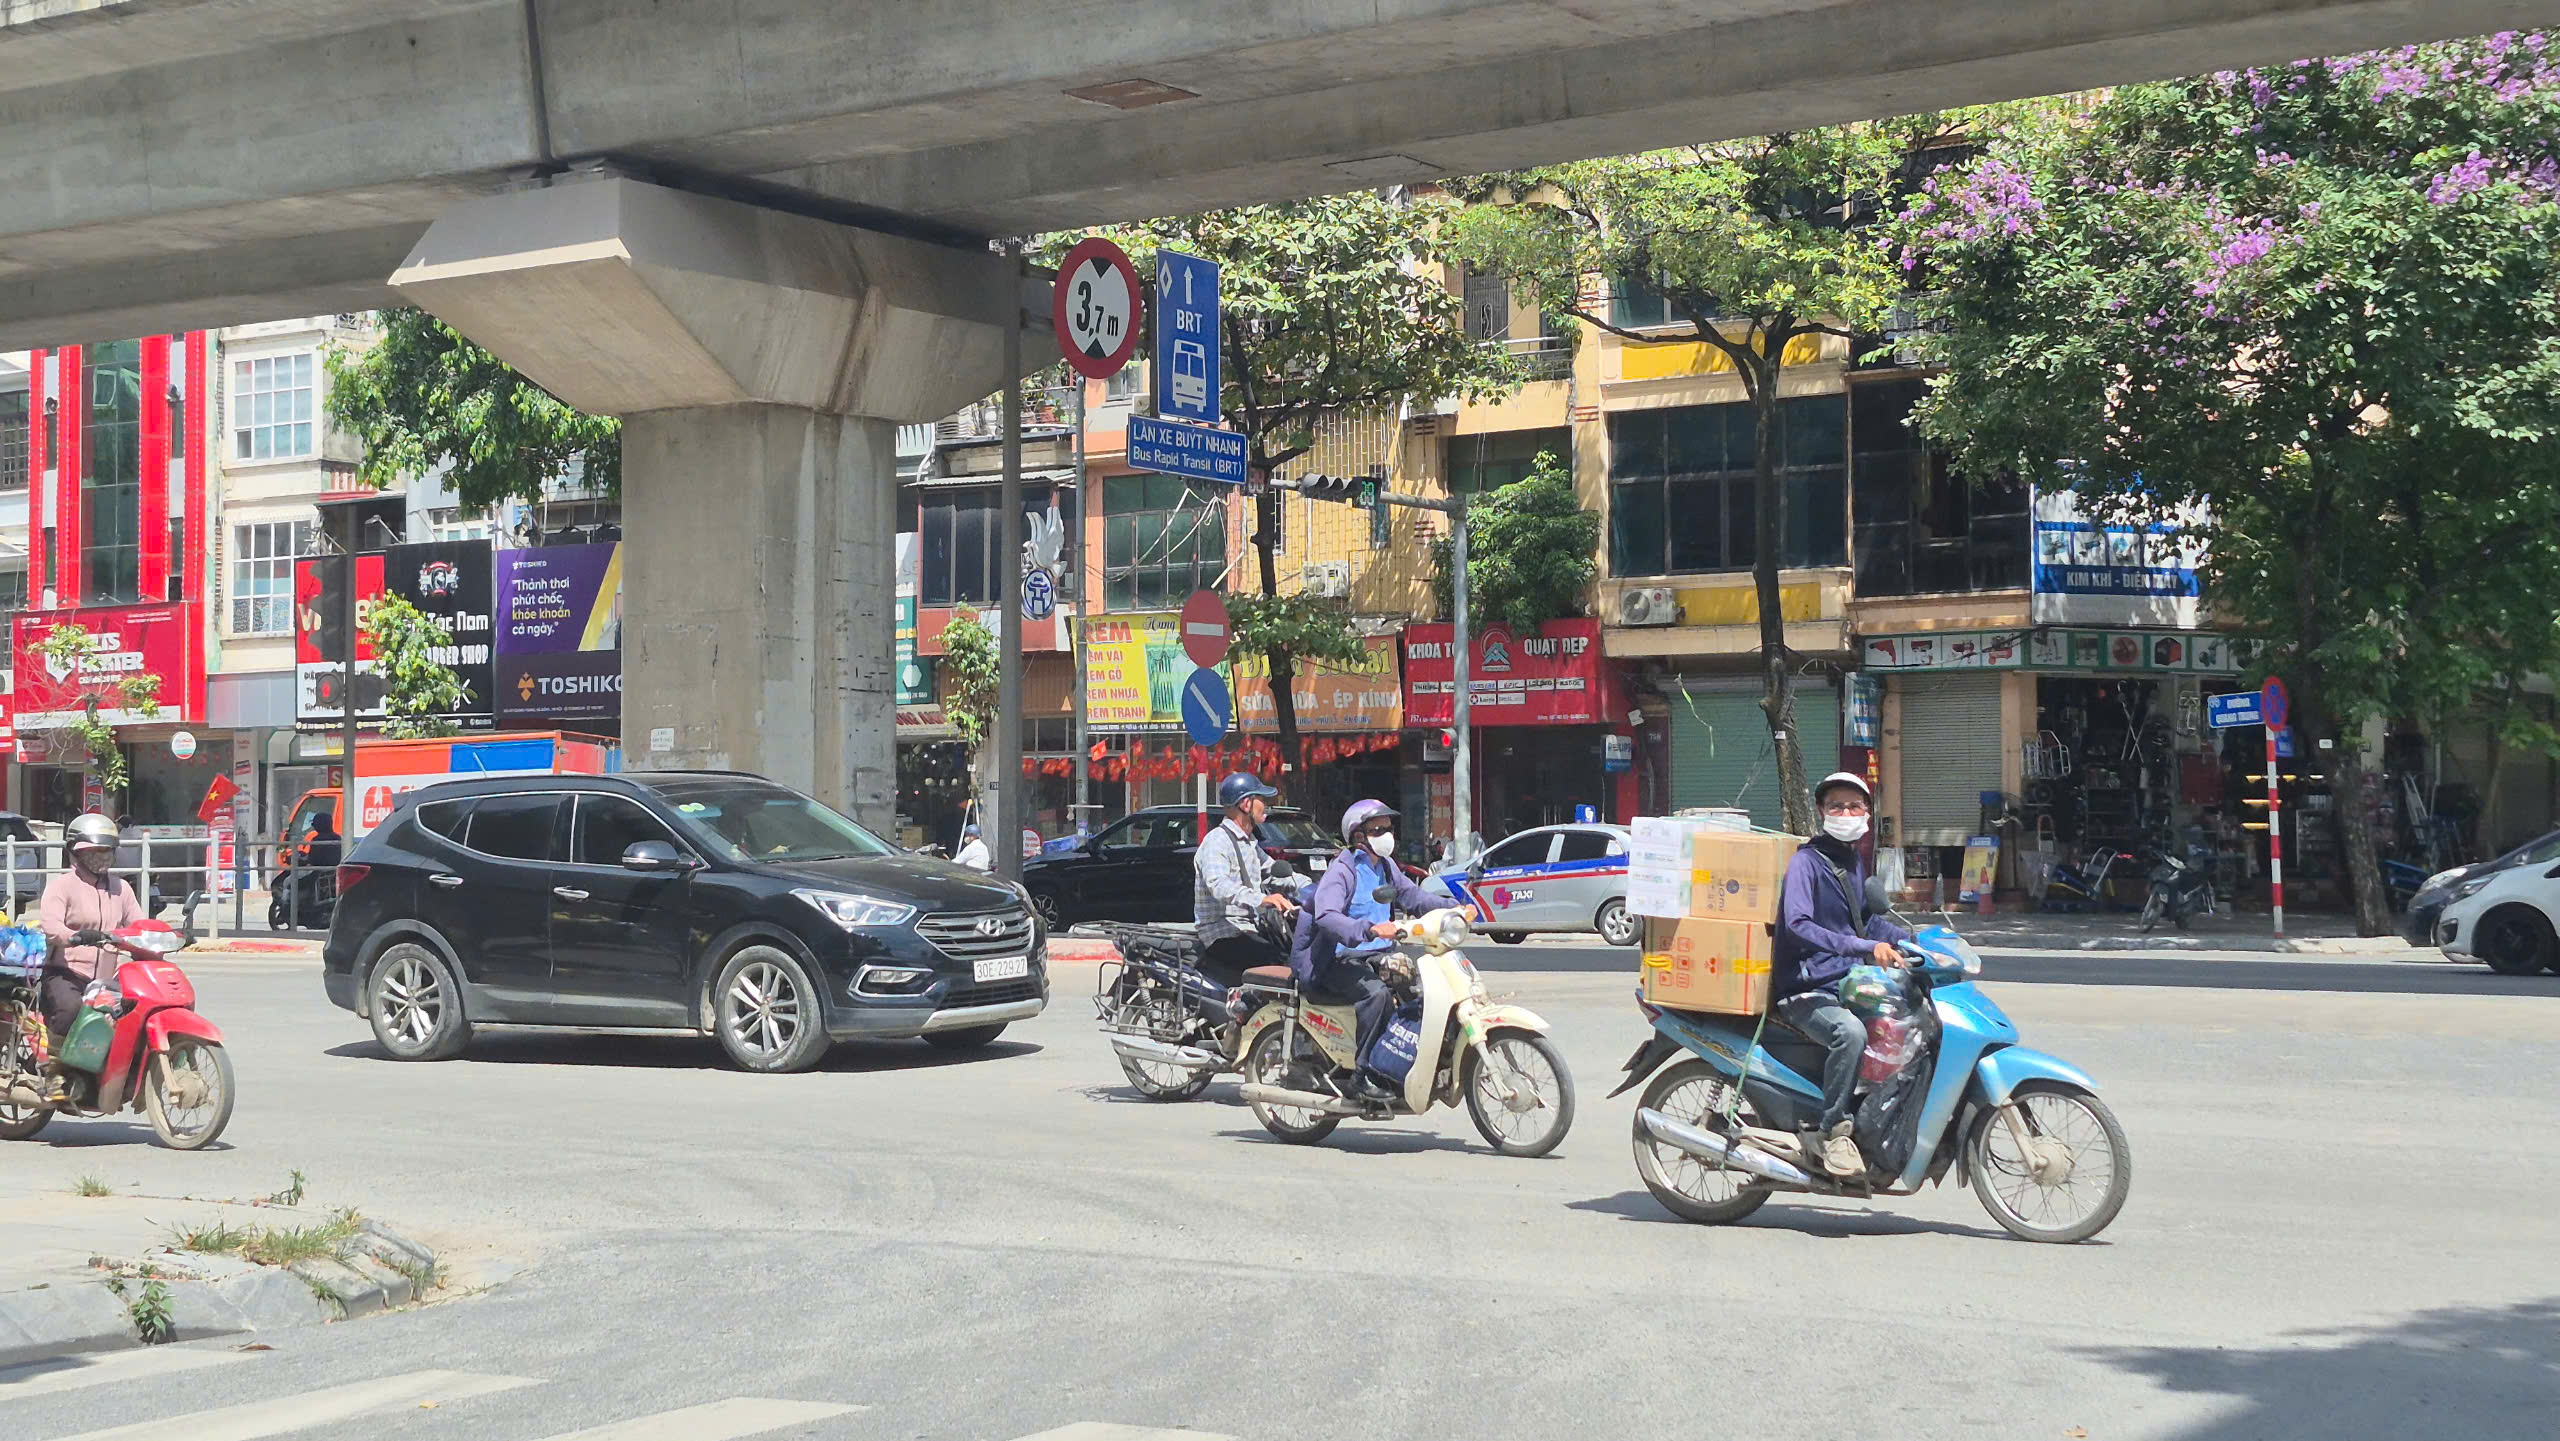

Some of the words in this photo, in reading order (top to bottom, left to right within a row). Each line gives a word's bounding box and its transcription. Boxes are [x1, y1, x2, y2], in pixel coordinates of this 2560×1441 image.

[1076, 280, 1104, 338] 3,7
[1176, 308, 1202, 334] BRT
[1133, 421, 1156, 443] LÀN
[1160, 428, 1173, 446] XE
[1176, 428, 1203, 450] BUÝT
[1206, 436, 1241, 457] NHANH
[1133, 446, 1152, 462] Bus
[1155, 448, 1179, 468] Rapid
[1181, 453, 1211, 471] Transit
[1215, 458, 1242, 476] (BRT)
[2066, 571, 2089, 587] KIM
[512, 594, 535, 608] phút
[461, 643, 489, 665] SHOP
[1524, 638, 1557, 659] QUẠT
[1512, 889, 1534, 901] TAXI
[976, 962, 995, 979] 30E
